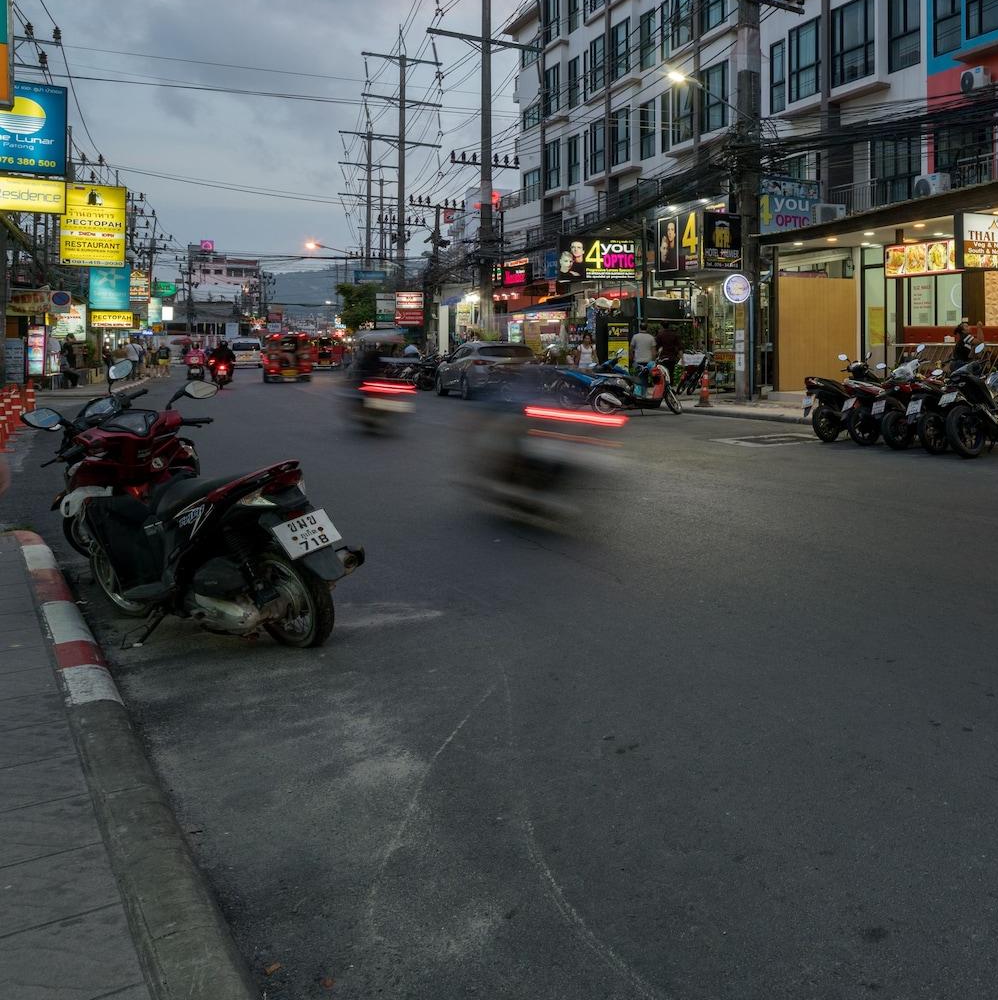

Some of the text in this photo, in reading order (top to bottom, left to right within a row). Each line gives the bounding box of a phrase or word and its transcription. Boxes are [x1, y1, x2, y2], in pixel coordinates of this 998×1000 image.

[16, 133, 55, 145] Lunar
[2, 141, 35, 151] Patong
[17, 157, 36, 166] 380
[38, 159, 57, 168] 500
[0, 188, 62, 203] esidence
[775, 213, 810, 228] OPTIC
[682, 212, 698, 254] 4
[968, 230, 995, 241] THAI
[65, 241, 121, 249] RESTAURANT
[603, 253, 635, 269] OPTIC
